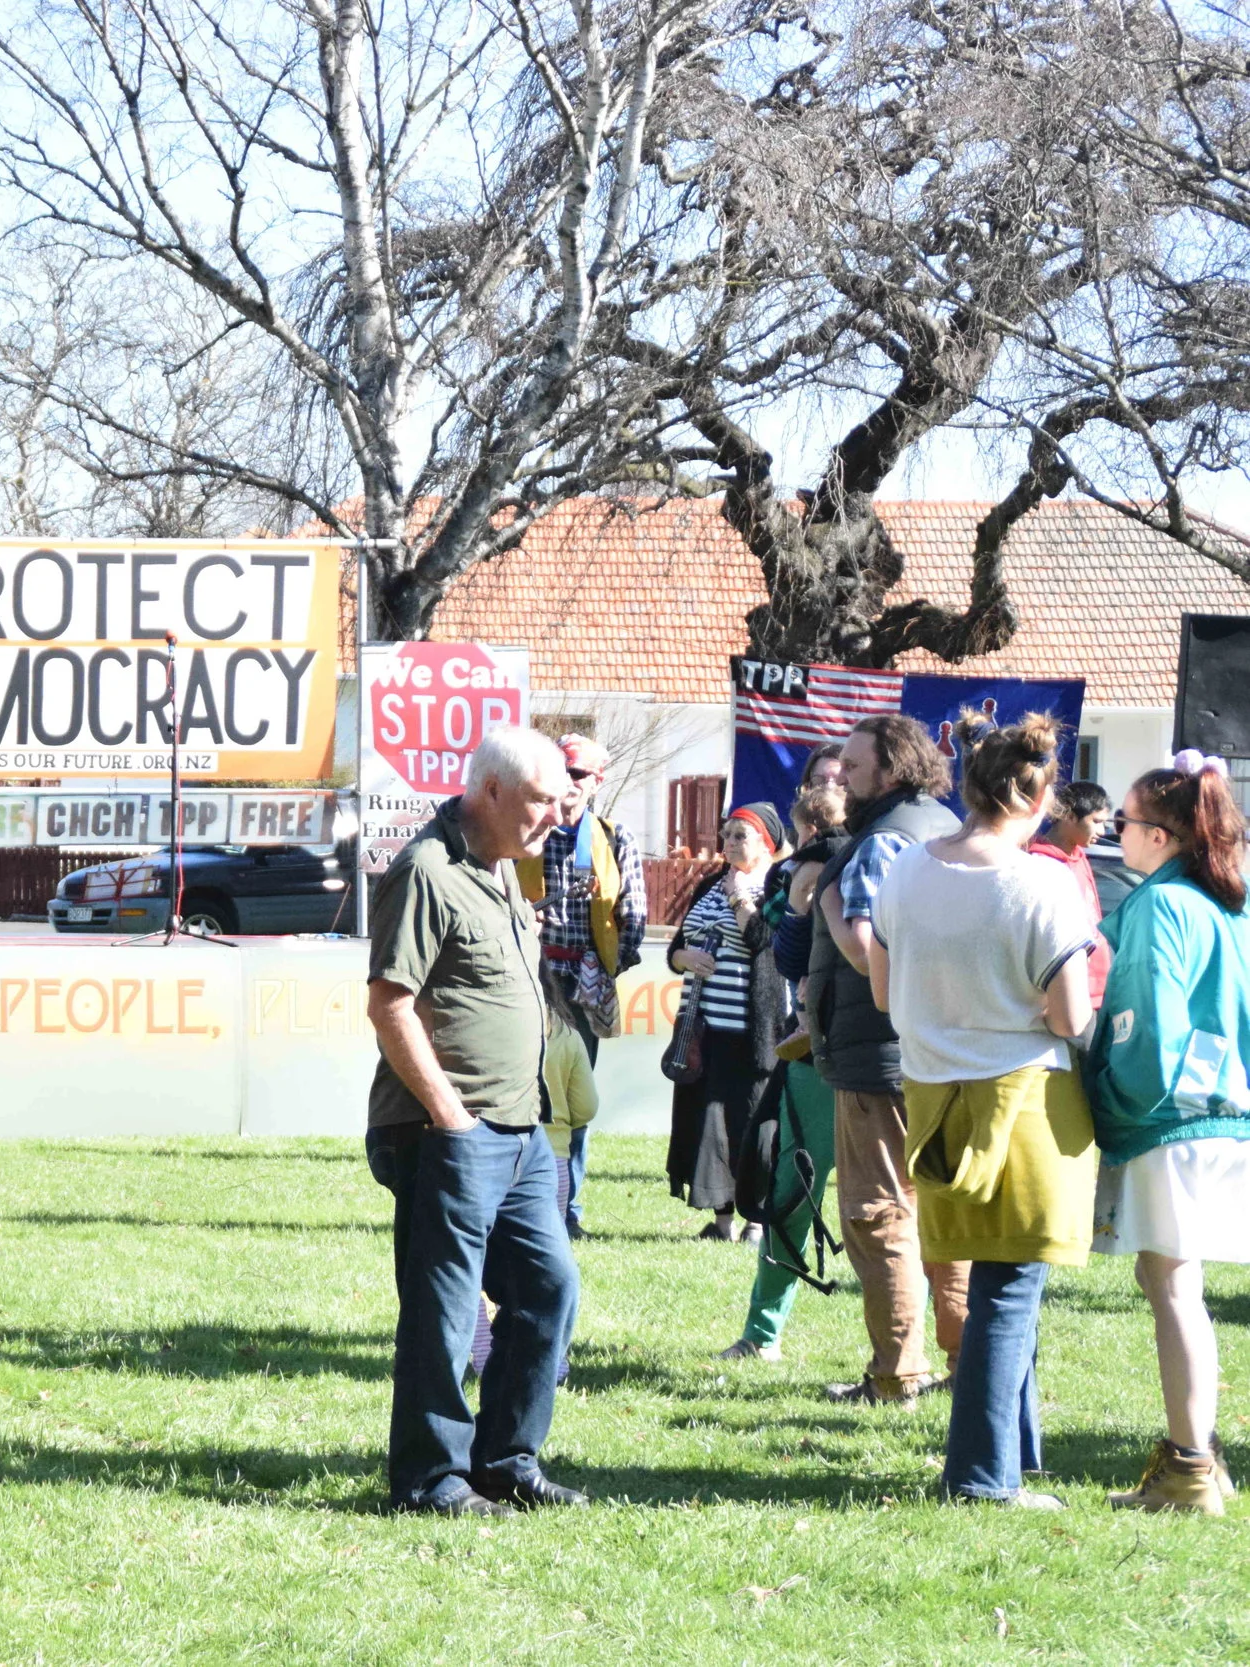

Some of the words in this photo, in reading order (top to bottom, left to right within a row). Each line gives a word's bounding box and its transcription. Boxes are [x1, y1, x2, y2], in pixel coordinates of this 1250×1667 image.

[376, 656, 433, 688] We
[441, 657, 520, 690] Can
[380, 692, 512, 749] STOP
[14, 753, 56, 769] OUR
[368, 793, 422, 815] Ring
[46, 802, 135, 838] CHCH
[158, 801, 219, 837] TPP
[239, 801, 314, 837] FREE
[362, 821, 428, 838] Emai
